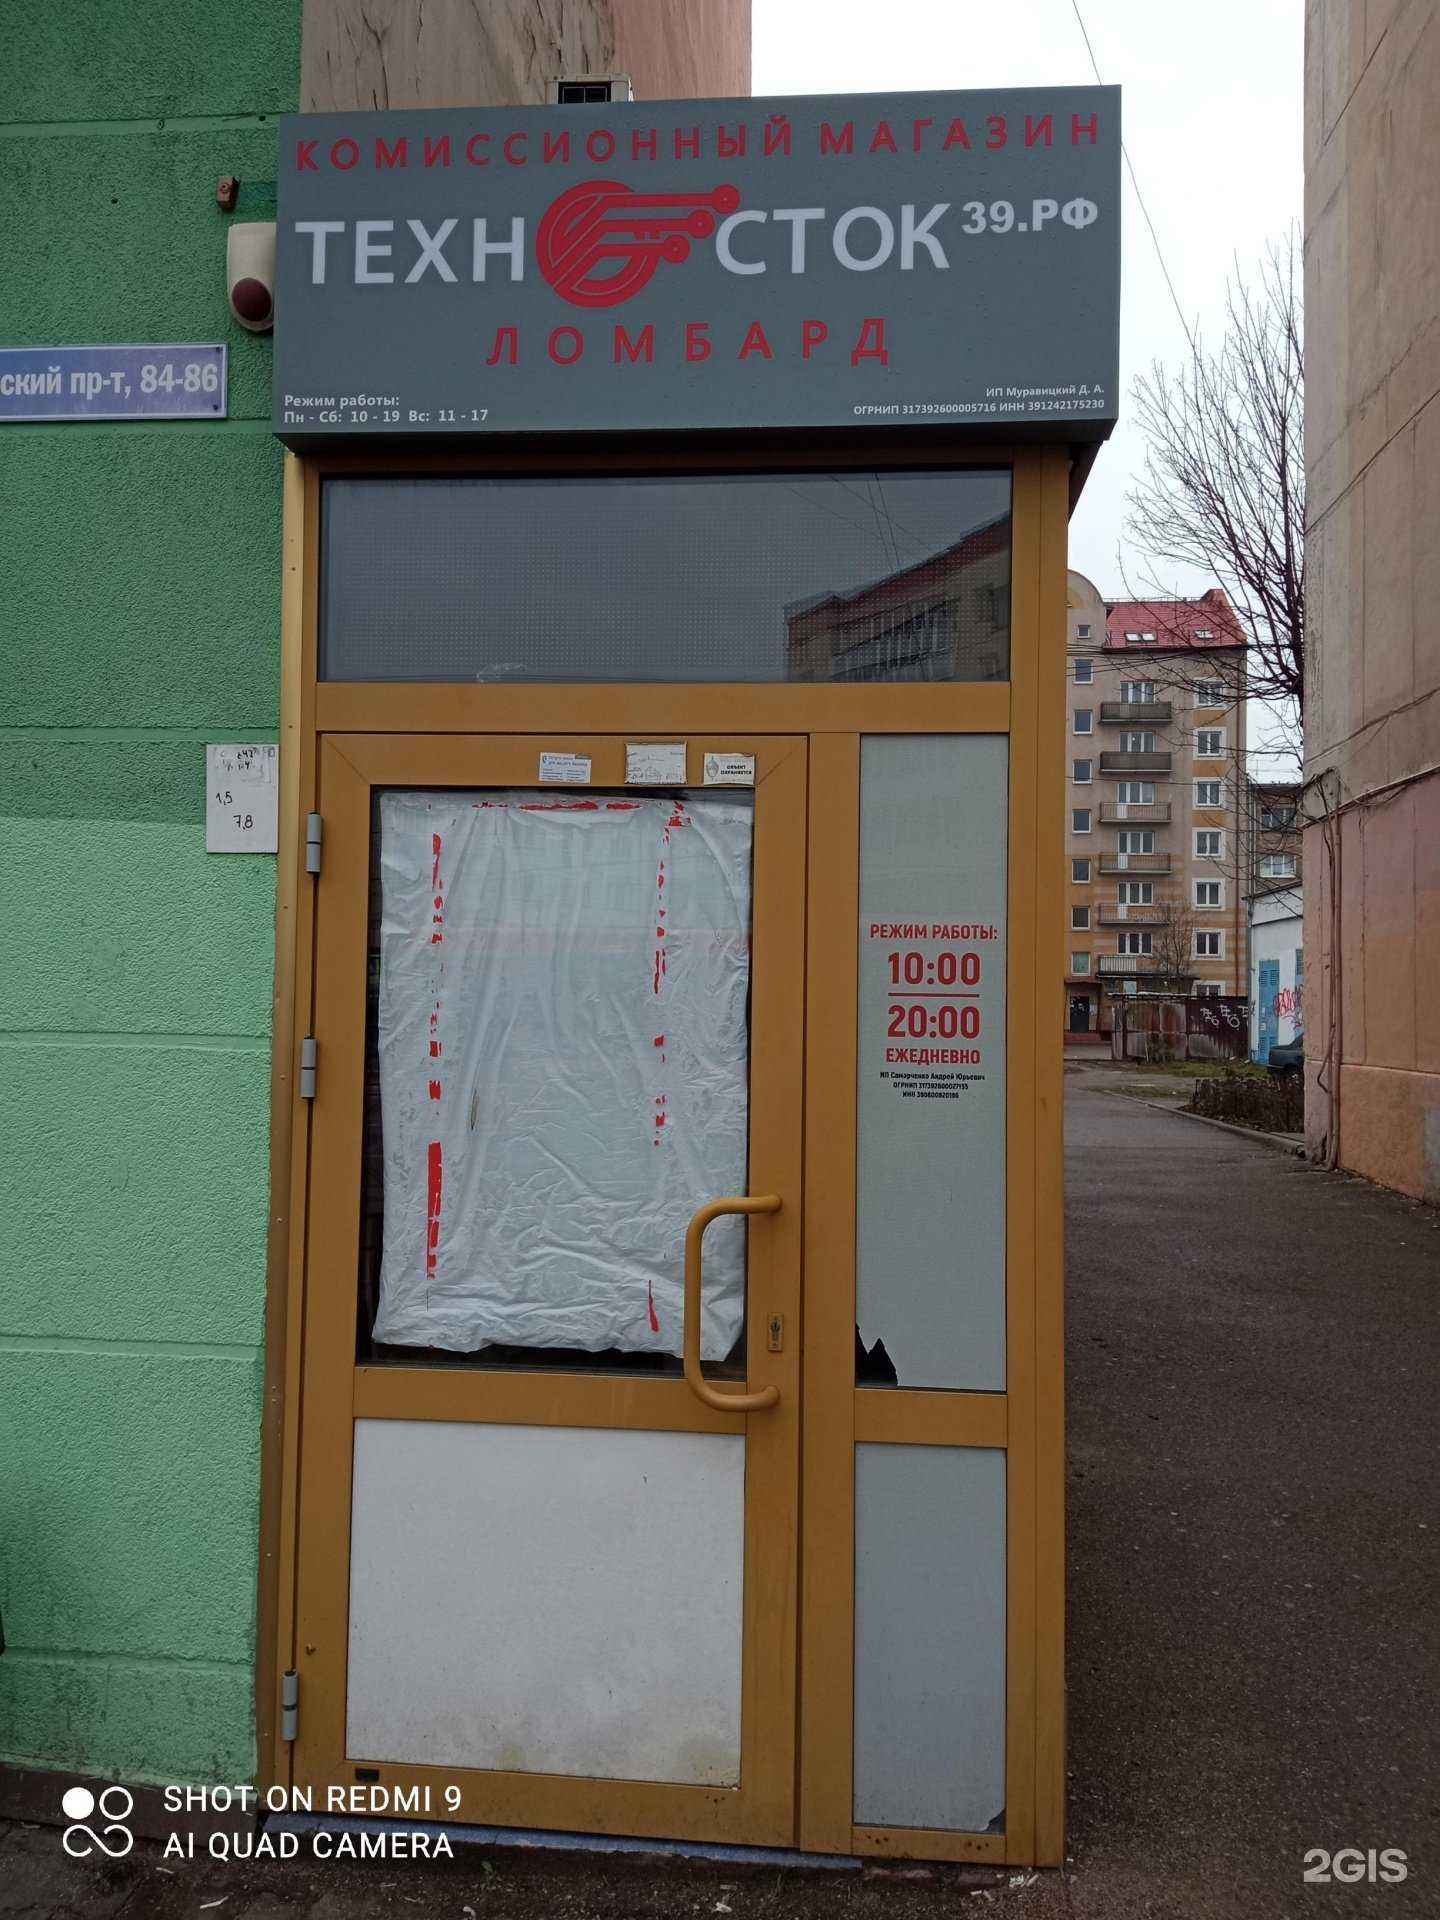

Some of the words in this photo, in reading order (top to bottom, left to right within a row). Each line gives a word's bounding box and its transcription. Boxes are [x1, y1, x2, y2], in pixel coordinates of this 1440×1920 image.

[296, 115, 792, 171] КОМИССИОННЫЙ
[819, 113, 1098, 155] МАГАЗИН
[962, 198, 1098, 234] 39.РФ
[486, 318, 889, 367] ЛОМБАРД
[70, 371, 131, 400] пр-т,
[140, 363, 218, 393] 84-86
[986, 387, 1003, 397] ИП
[284, 395, 335, 407] Режим
[340, 395, 400, 409] работы:
[854, 405, 899, 415] ОГРНИП
[1000, 402, 1025, 412] ИНН
[284, 412, 304, 423] Пн
[319, 411, 342, 423] Сб:
[351, 411, 368, 422] 10
[383, 411, 400, 422] 19
[408, 411, 430, 422] Вс:
[438, 410, 455, 421] 11
[471, 410, 488, 421] 17
[870, 924, 928, 939] РЕЖИМ
[932, 924, 998, 940] РАБОТЫ:
[888, 951, 981, 986] 10:00
[888, 1004, 981, 1039] 20:00
[886, 1048, 981, 1065] ЕЖЕДНЕВНО
